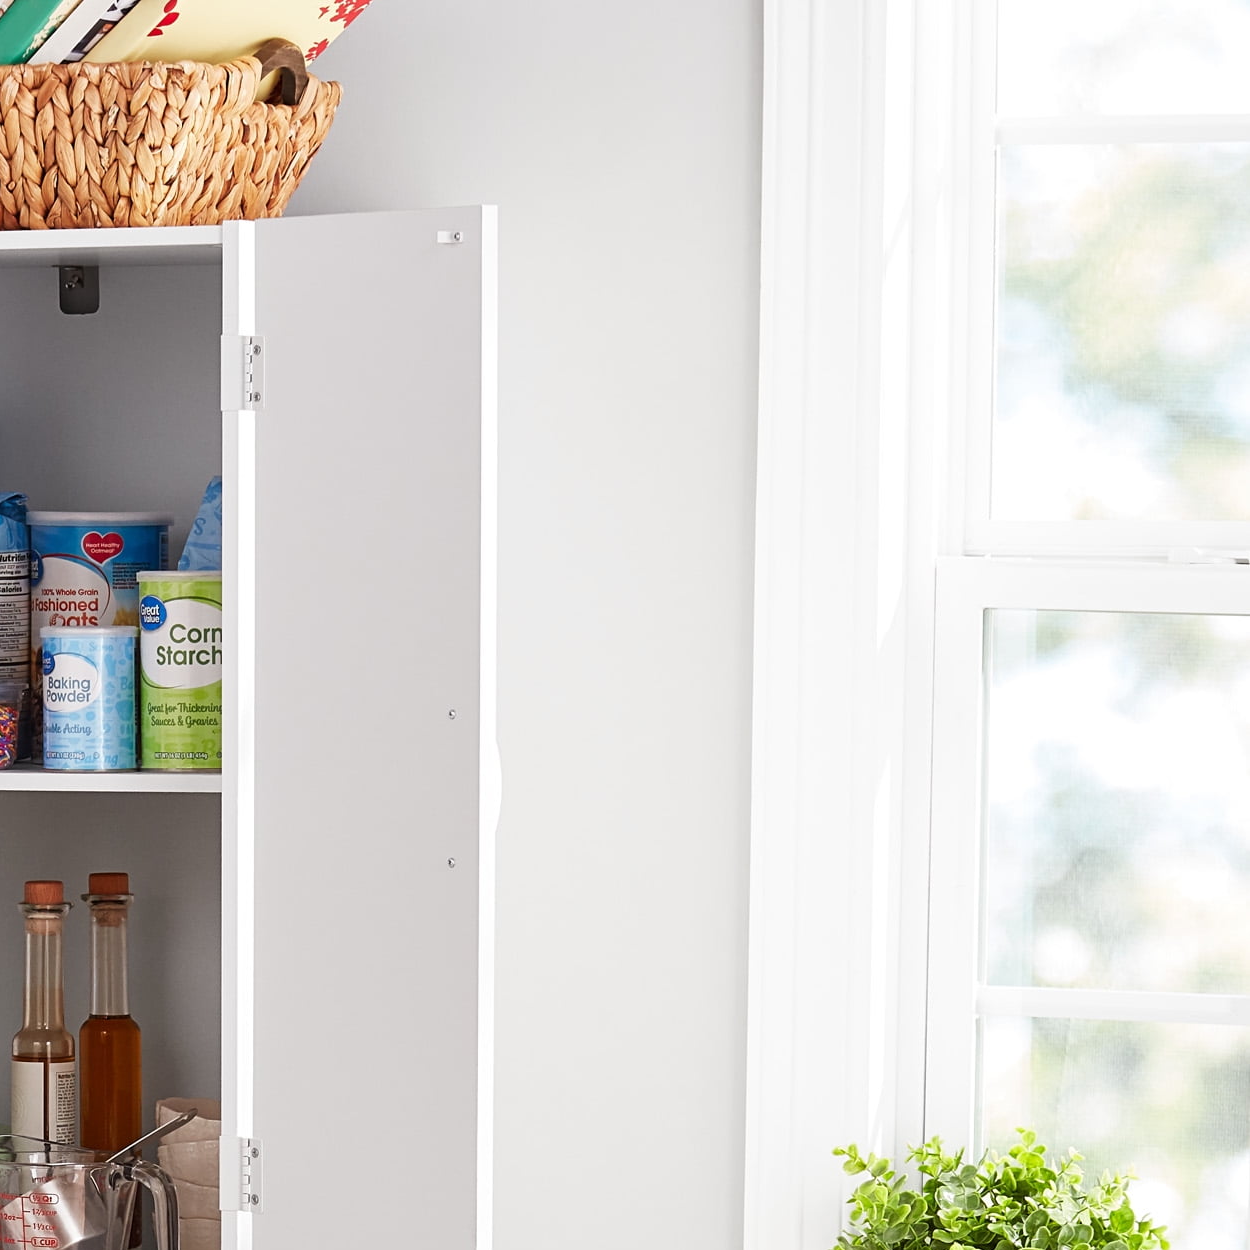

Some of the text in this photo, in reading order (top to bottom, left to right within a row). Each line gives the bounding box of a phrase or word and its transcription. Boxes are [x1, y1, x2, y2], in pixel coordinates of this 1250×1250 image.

[41, 588, 99, 596] 100% Whole Grain
[35, 598, 99, 612] Fashioned
[141, 604, 160, 616] Great
[143, 615, 160, 623] Value
[169, 623, 222, 643] Corn
[156, 645, 222, 666] Starch
[48, 677, 91, 692] Baking
[46, 690, 91, 703] Powder
[147, 702, 222, 715] Great for Thickening
[151, 715, 218, 728] Sauces & Gravies
[62, 723, 92, 736] Acting
